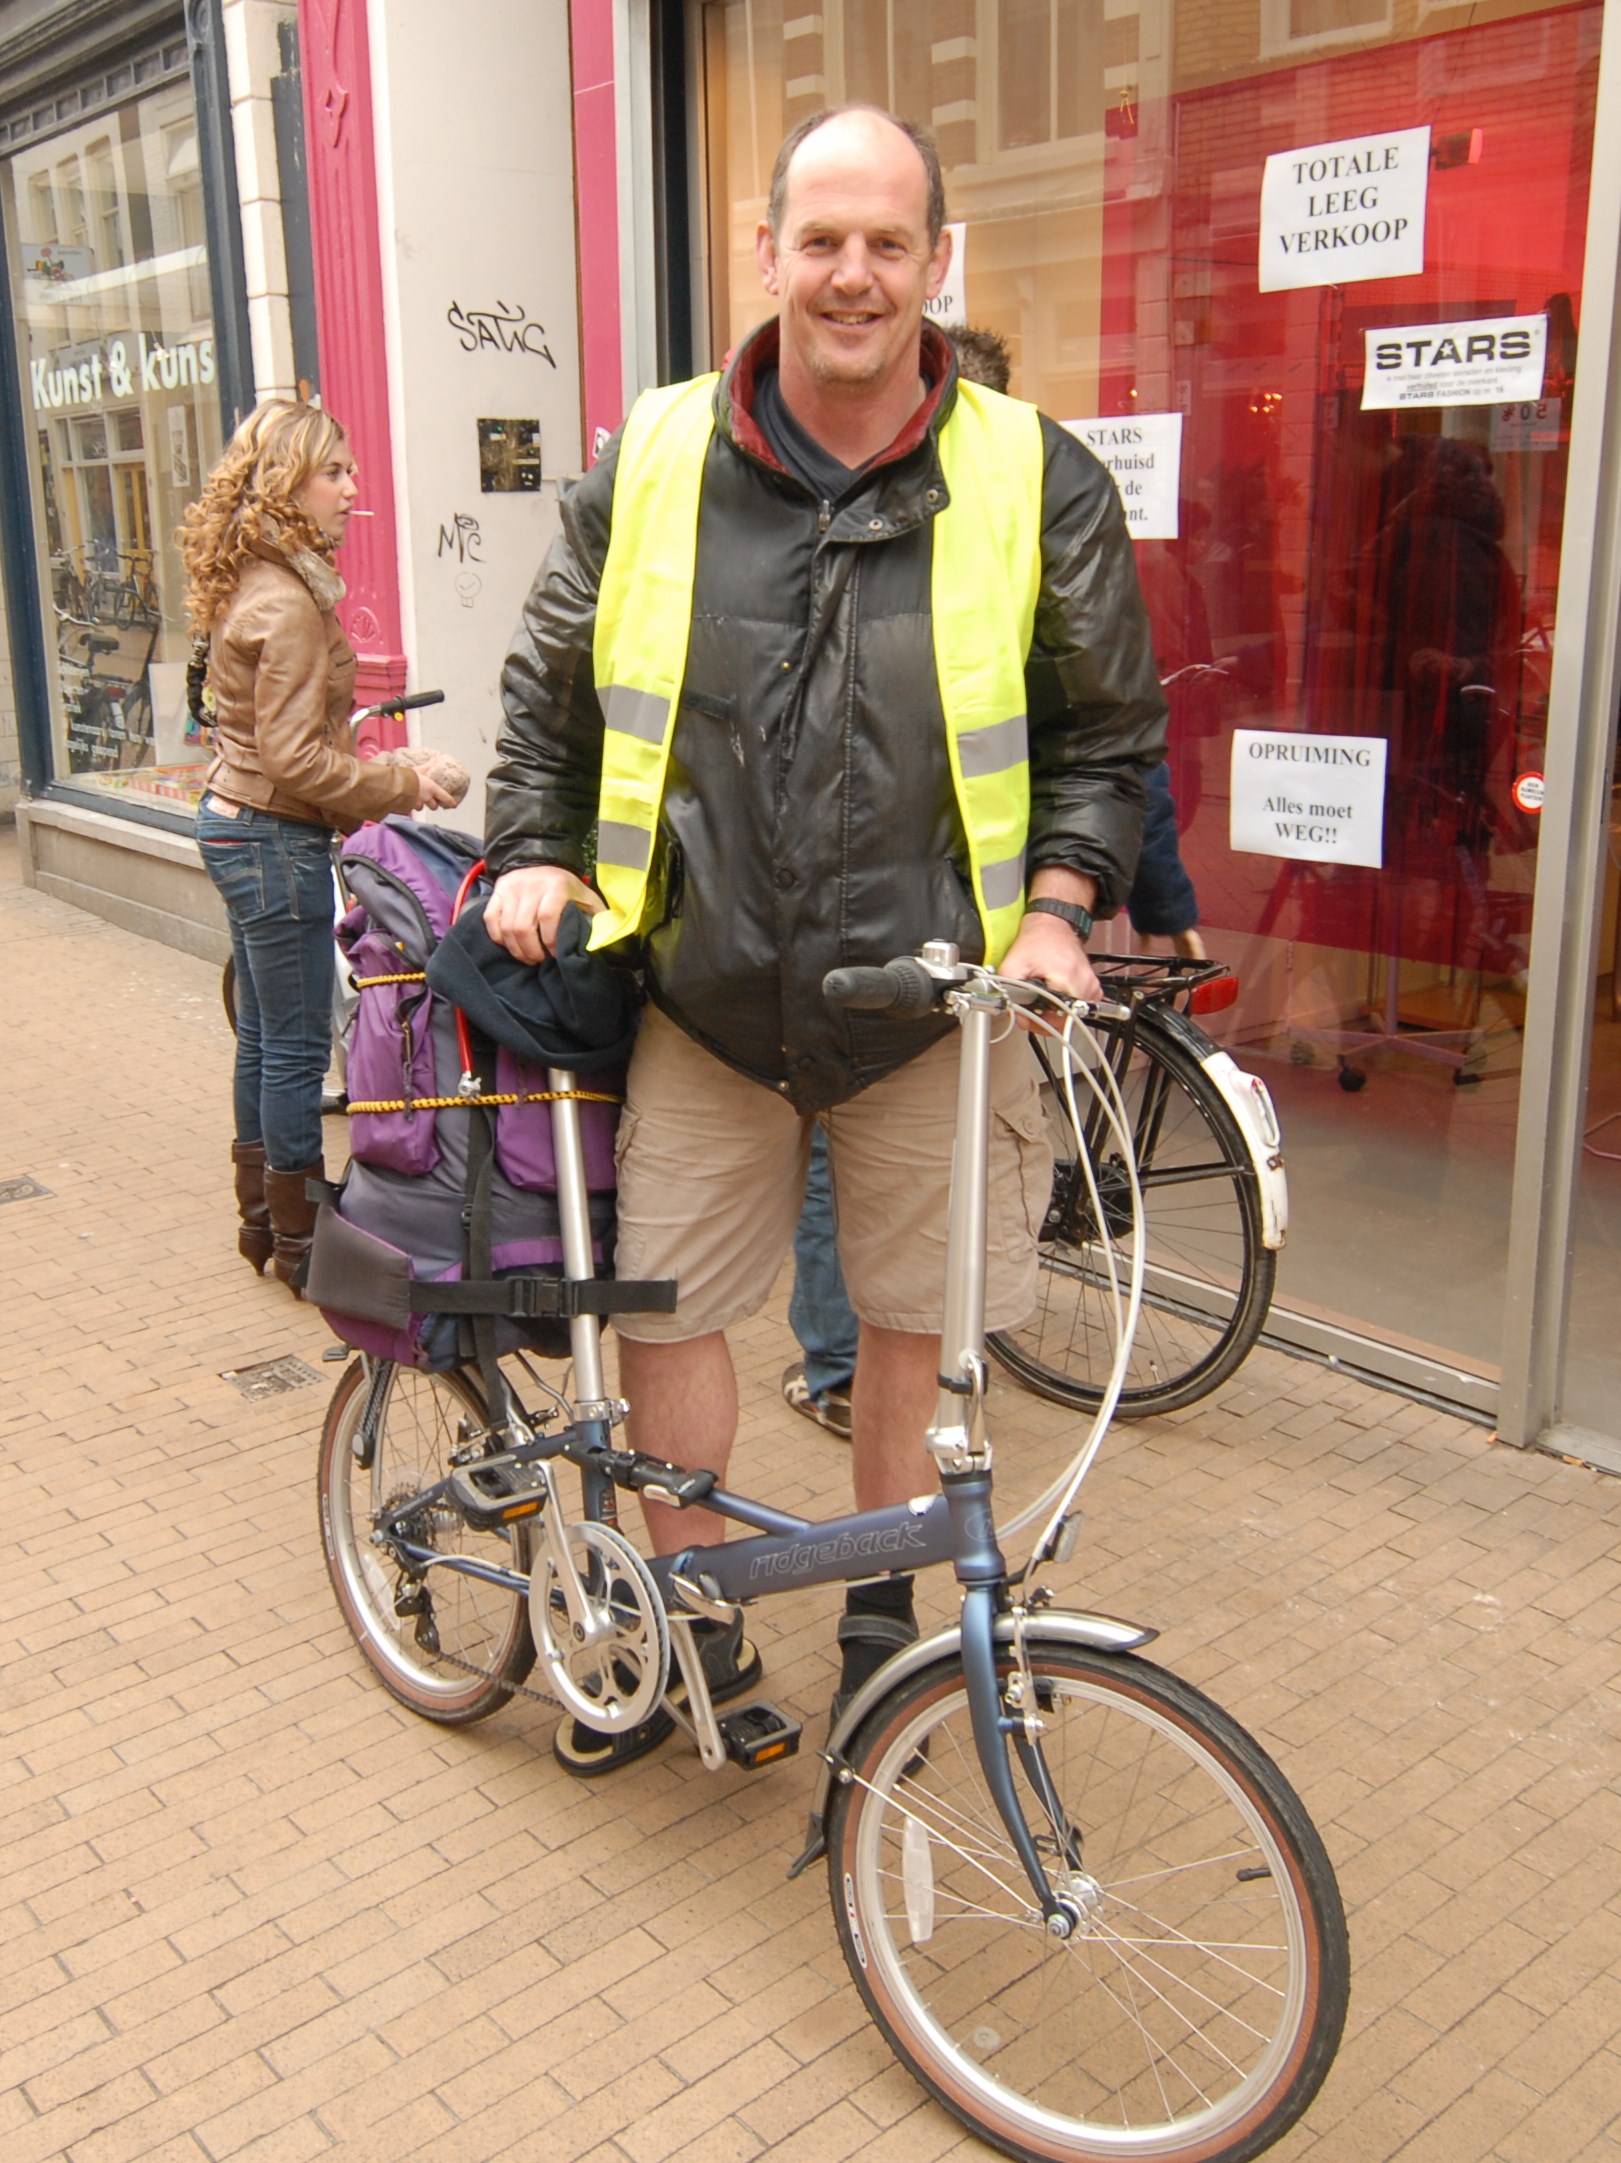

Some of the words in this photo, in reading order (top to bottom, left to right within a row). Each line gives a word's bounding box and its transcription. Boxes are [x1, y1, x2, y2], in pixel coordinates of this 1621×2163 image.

[1292, 146, 1400, 186] TOTALE
[1308, 186, 1379, 218] LEEG
[1279, 218, 1409, 255] VERKOOP
[1376, 330, 1531, 370] STARS
[30, 353, 103, 410] Kunst
[109, 340, 135, 398] &
[1086, 427, 1143, 447] STARS
[1125, 479, 1143, 496] de
[1248, 741, 1371, 768] OPRUIMING
[1262, 796, 1304, 818] Alles
[1308, 802, 1353, 820] moet
[1274, 821, 1339, 845] WEG!!
[748, 1520, 928, 1580] ridgeback
